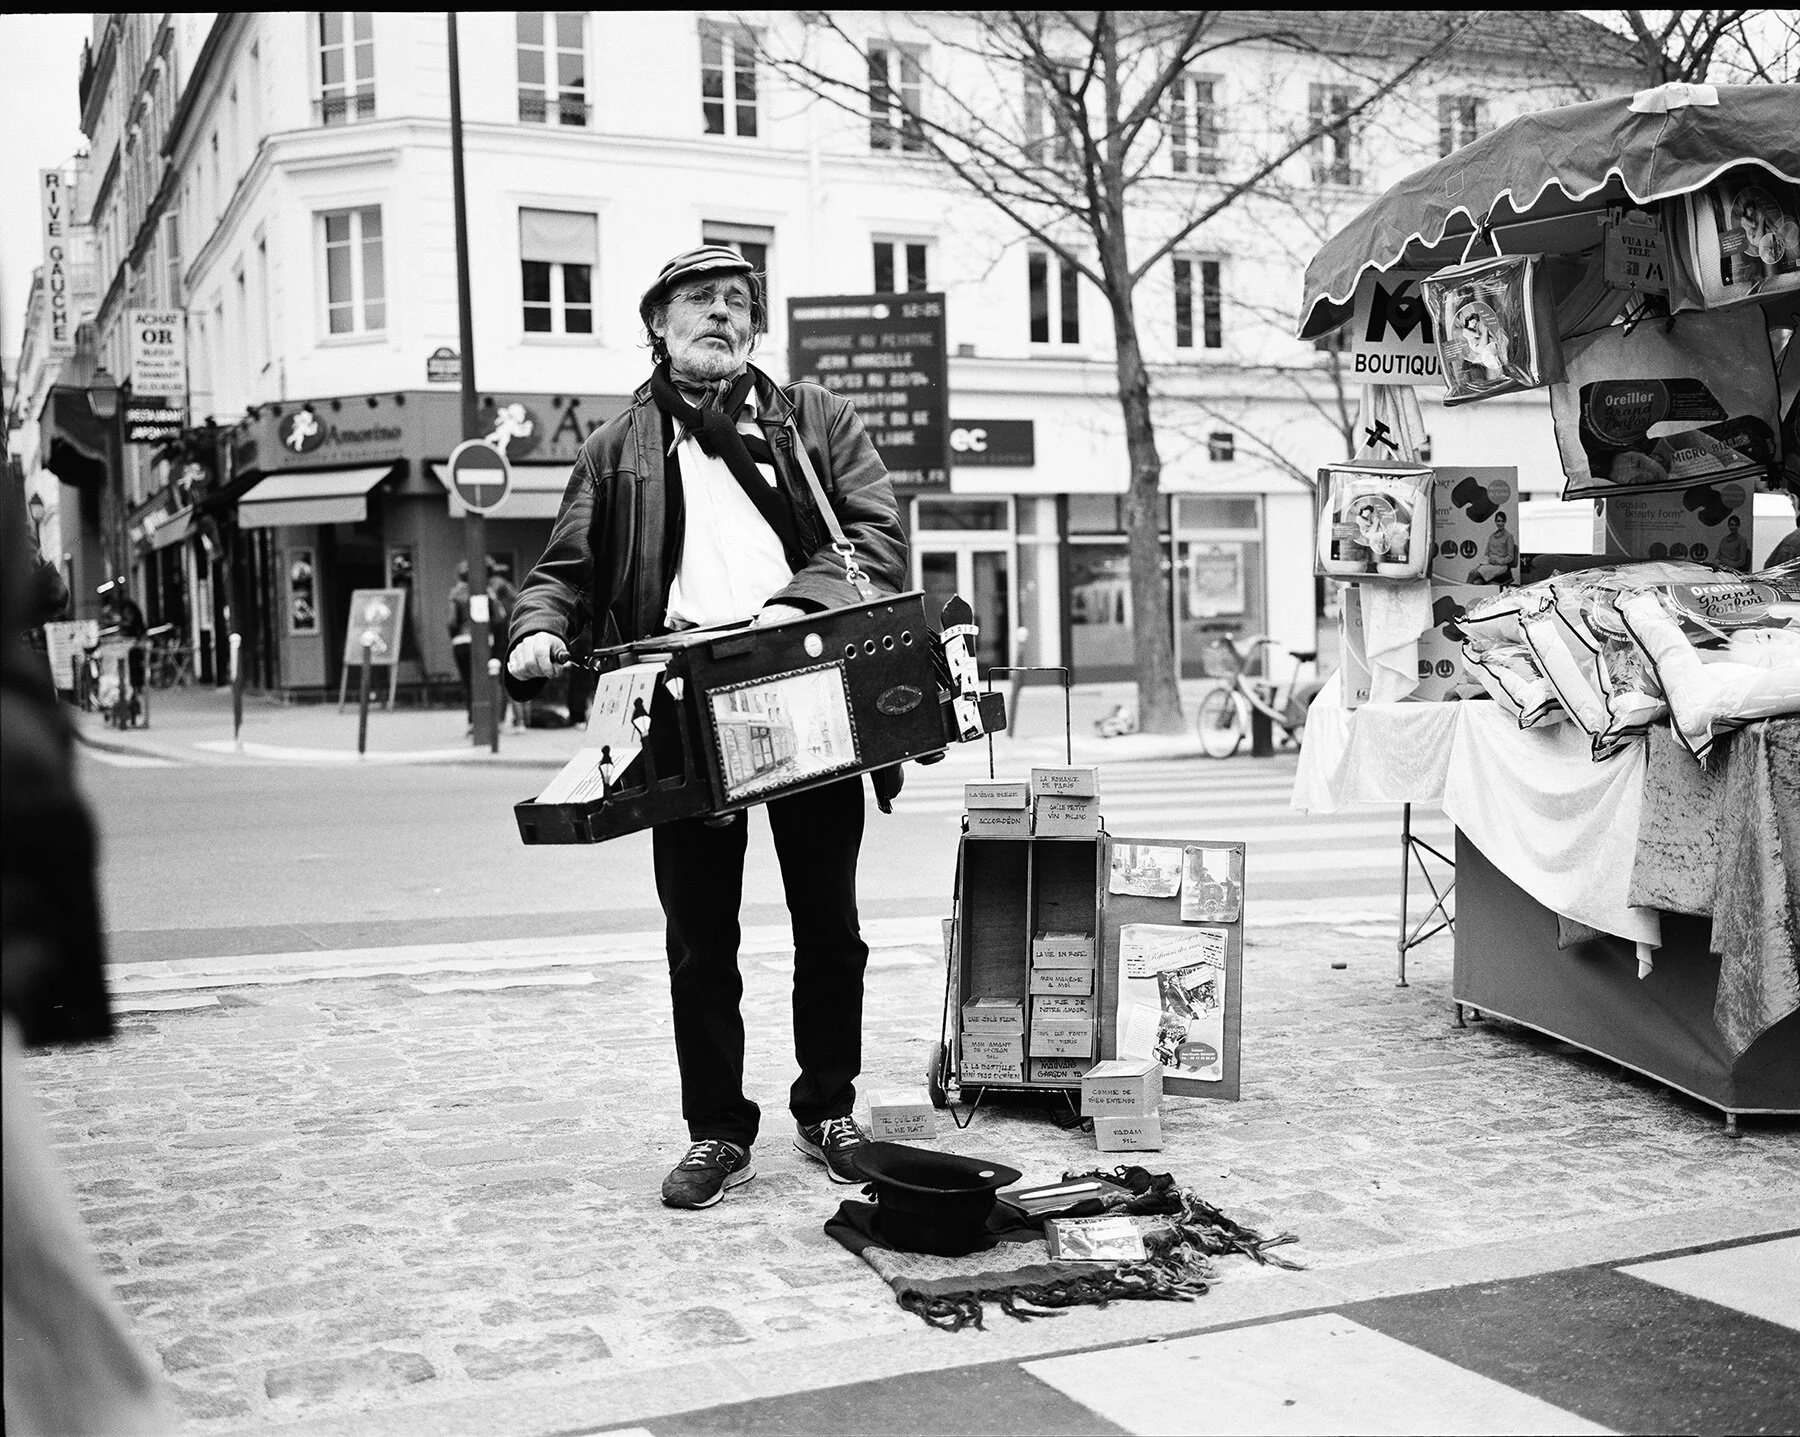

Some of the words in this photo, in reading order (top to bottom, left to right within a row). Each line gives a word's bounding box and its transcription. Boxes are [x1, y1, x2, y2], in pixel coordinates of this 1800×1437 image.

[45, 173, 62, 238] RIVE
[49, 245, 67, 341] GAUCHE
[142, 329, 172, 344] OR
[1355, 353, 1442, 376] BOUTIQU
[1605, 392, 1654, 407] Oreiller
[1706, 595, 1766, 617] Confort
[1041, 1062, 1077, 1070] MAUVAIS
